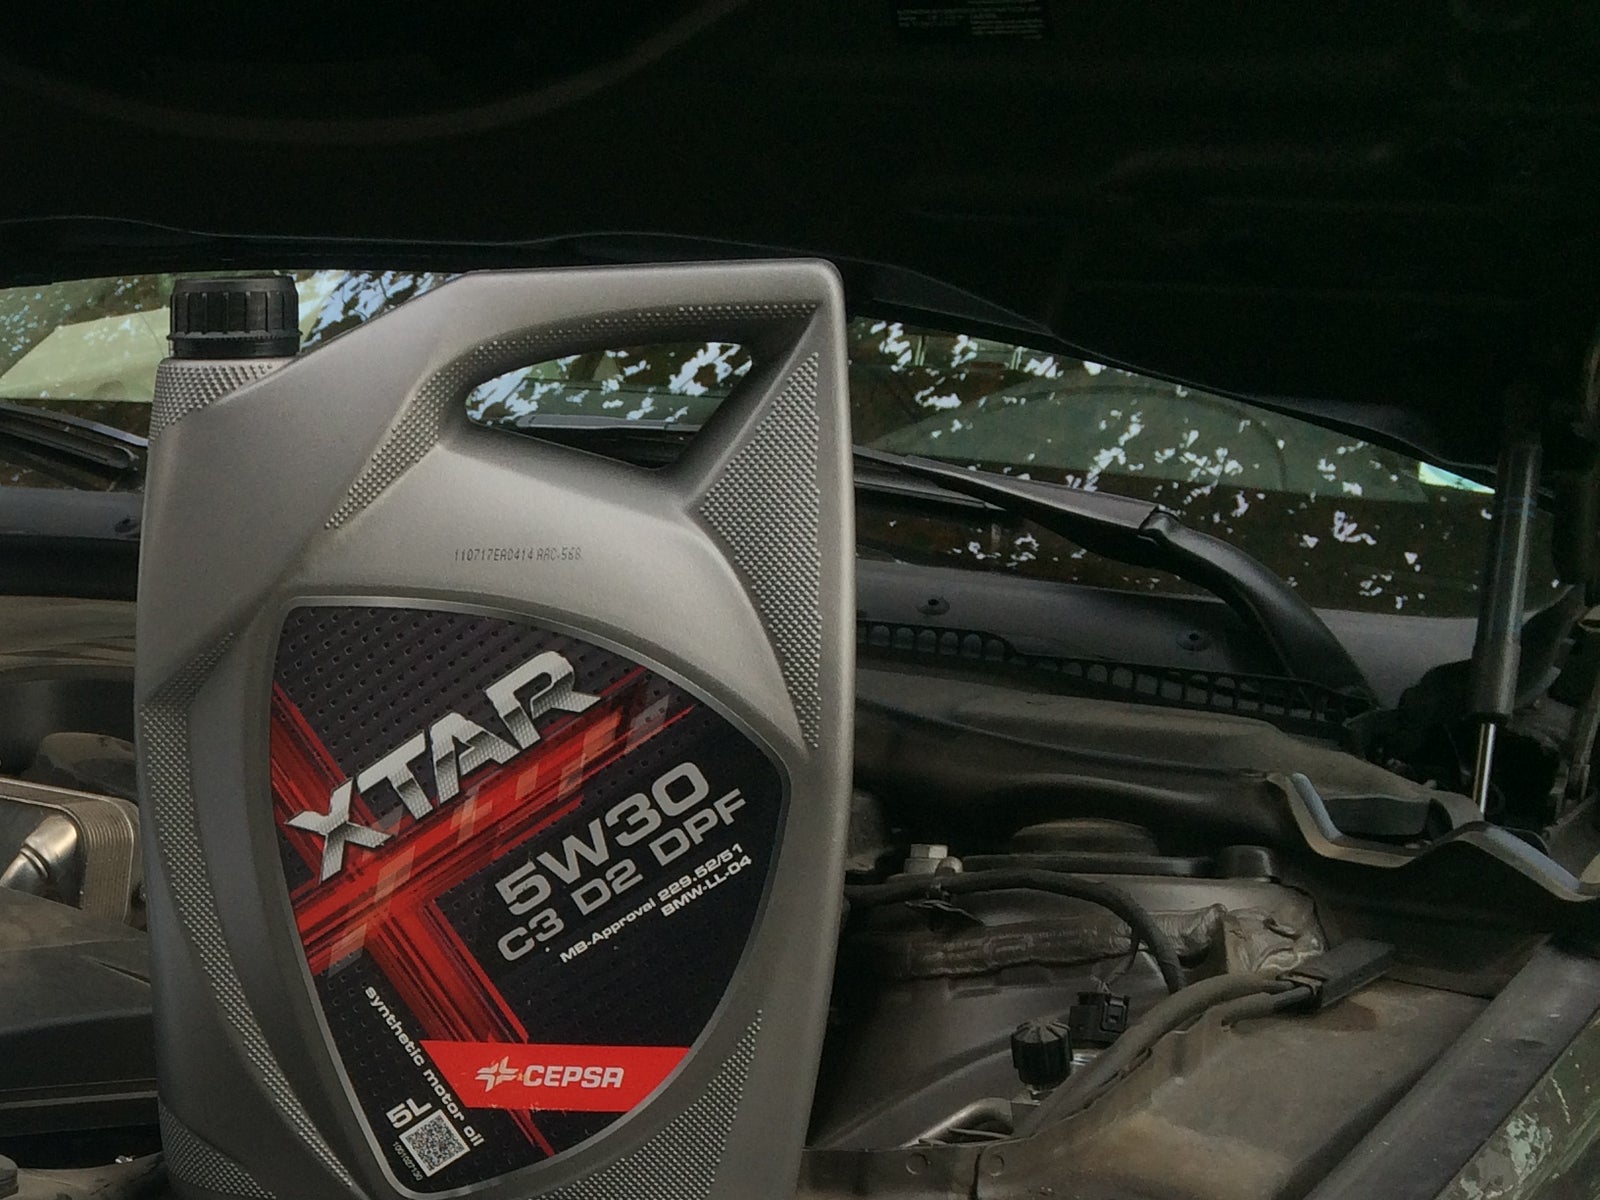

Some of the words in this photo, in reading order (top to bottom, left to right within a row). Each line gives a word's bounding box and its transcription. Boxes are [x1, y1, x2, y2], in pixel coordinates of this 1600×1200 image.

[284, 650, 601, 886] XTAR
[495, 762, 709, 916] 5W30
[497, 908, 564, 961] C3
[570, 858, 643, 916] D2
[649, 788, 746, 867] DPF
[560, 898, 657, 964] MB-Approval
[657, 843, 744, 902] 229.52/51
[661, 855, 752, 917] BMW-LL-04
[364, 986, 425, 1067] synthetic
[423, 1068, 465, 1121] motor
[463, 1125, 485, 1147] oil
[385, 1098, 433, 1129] 5L
[523, 1064, 625, 1088] CEPSA
